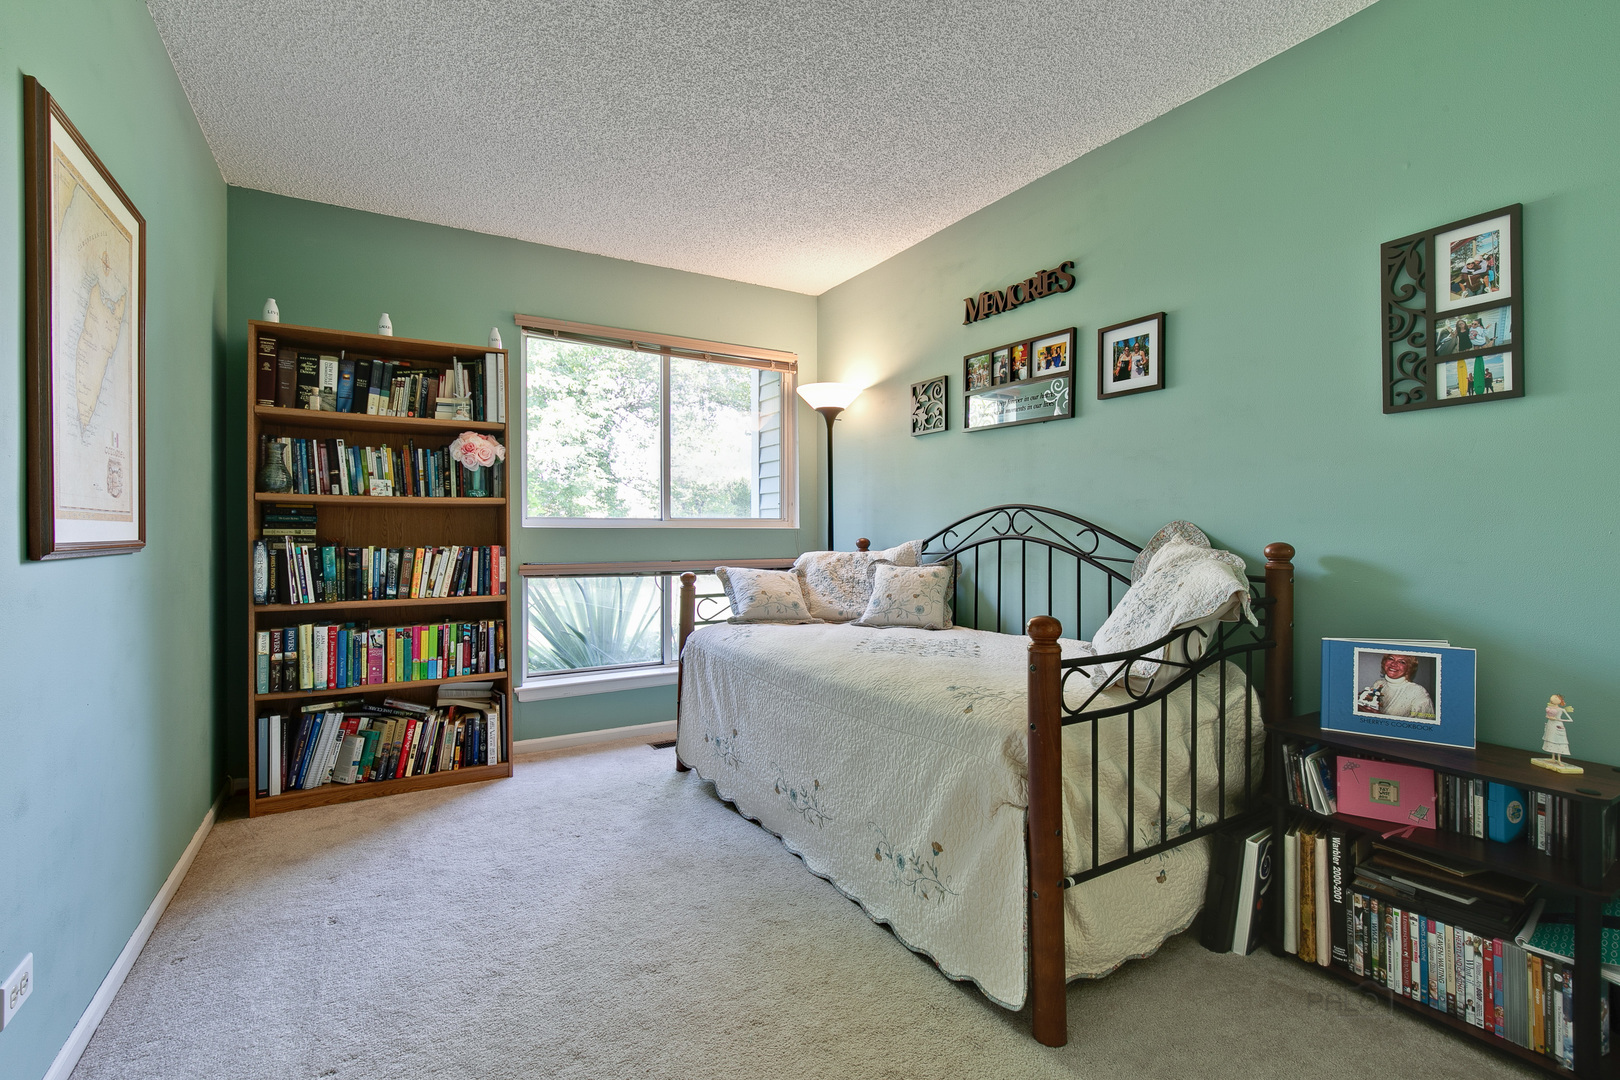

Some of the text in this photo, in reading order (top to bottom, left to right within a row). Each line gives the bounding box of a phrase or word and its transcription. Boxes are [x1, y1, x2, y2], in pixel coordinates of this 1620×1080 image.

[962, 260, 1076, 325] MEMORIES
[1360, 718, 1434, 731] SHERRY'S COOKBOOK
[1332, 837, 1342, 903] Warbler 2000-2001
[1466, 959, 1474, 977] What
